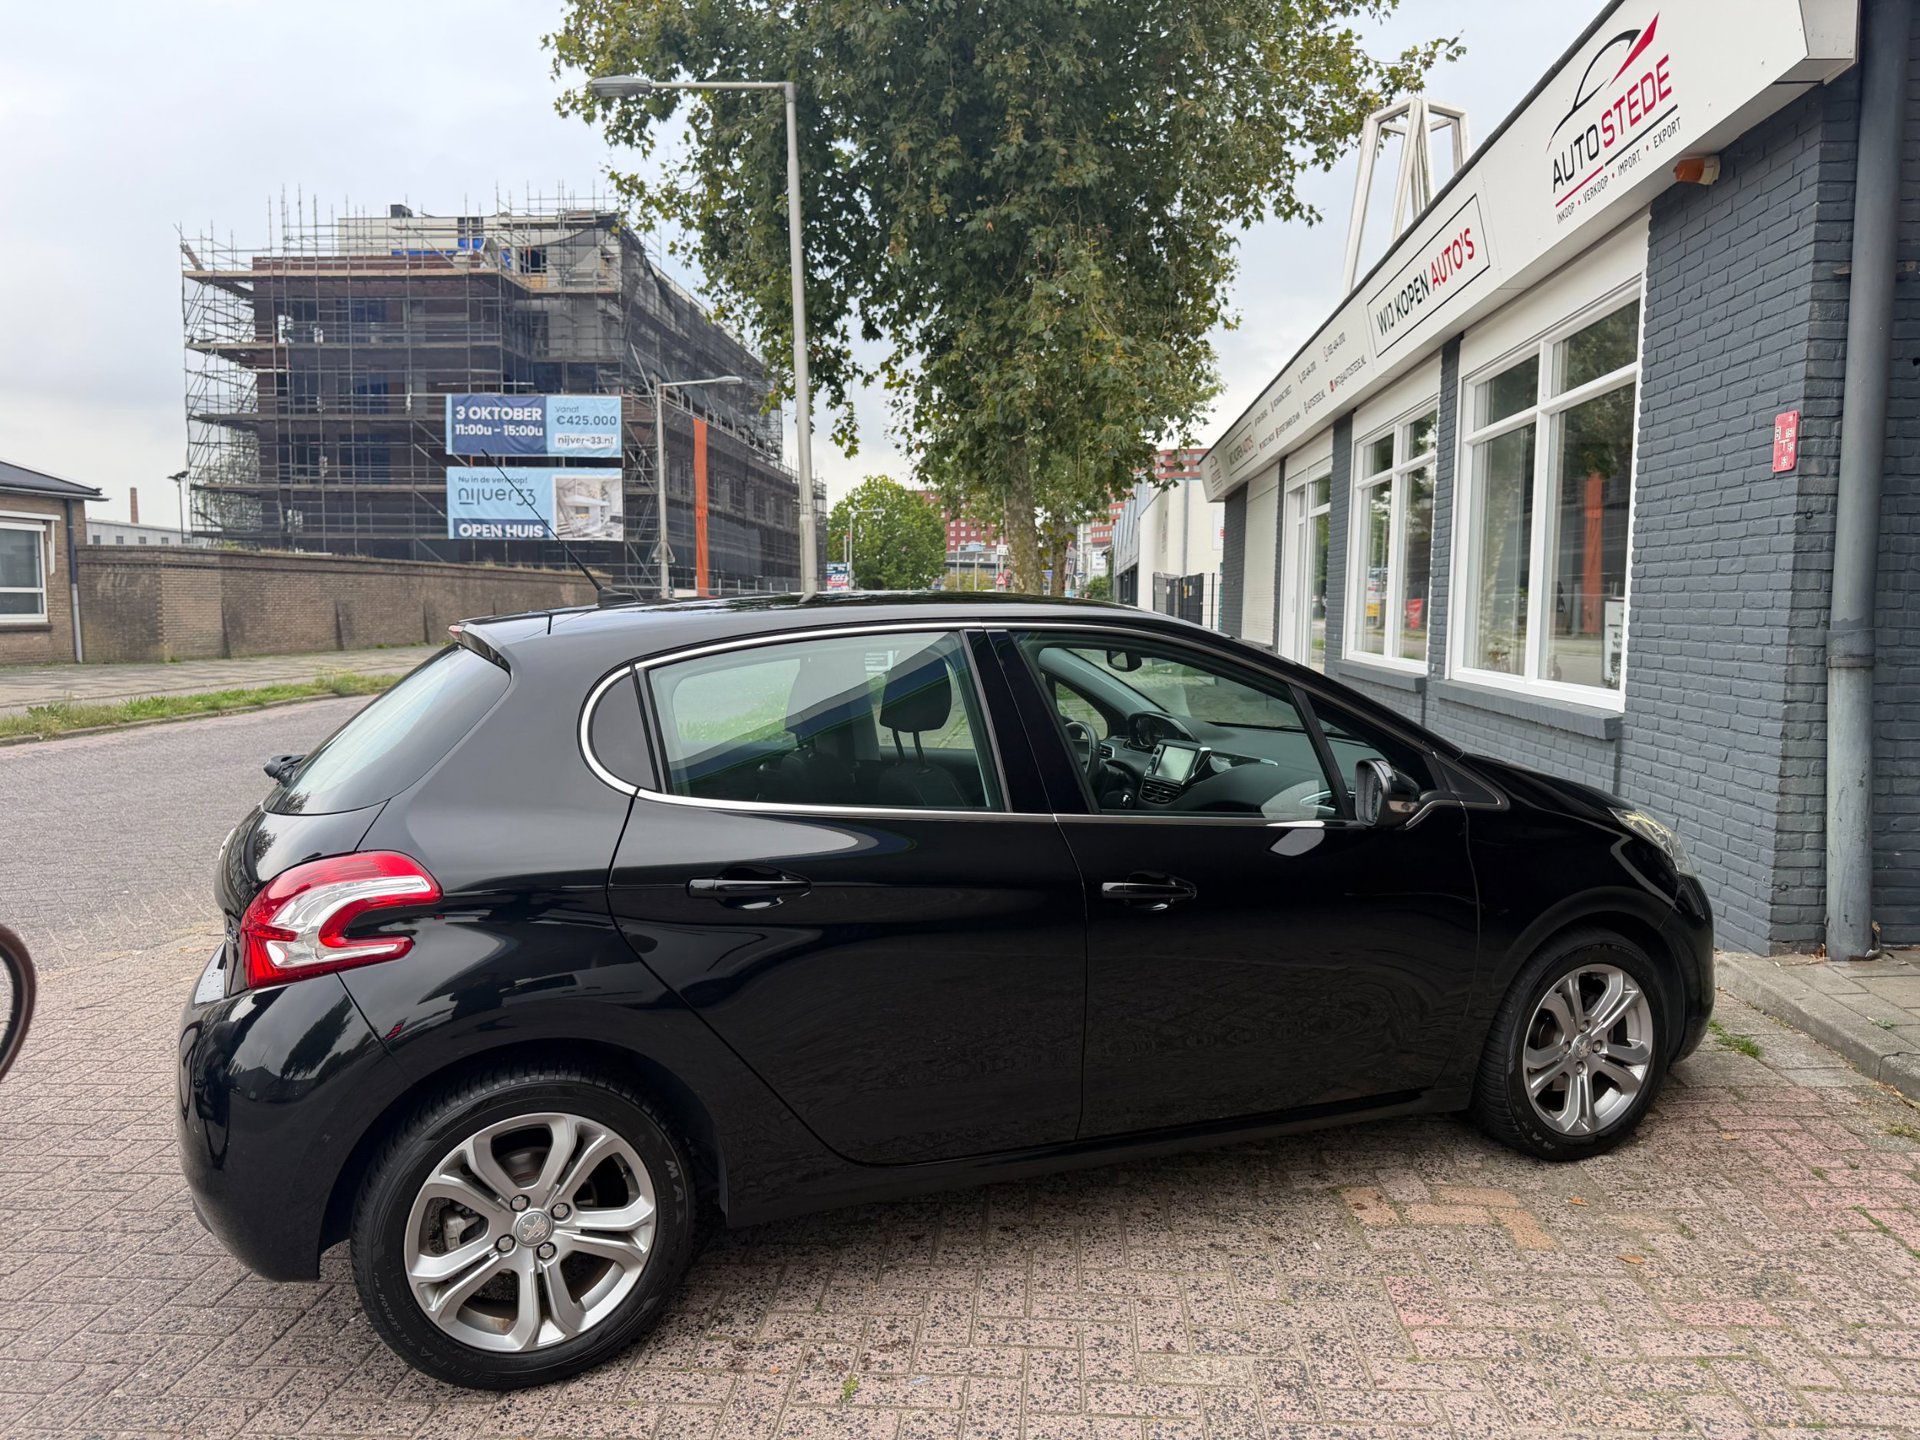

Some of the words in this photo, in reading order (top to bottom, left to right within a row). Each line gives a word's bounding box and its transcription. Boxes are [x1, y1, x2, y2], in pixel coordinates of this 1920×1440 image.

[1556, 202, 1575, 224] INKOOP
[1582, 175, 1609, 203] VERKOOP
[1617, 149, 1641, 176] IMPORT
[1653, 117, 1681, 149] EXPORT
[1376, 302, 1395, 336] WIJ
[1394, 269, 1430, 321] KOPEN
[1431, 227, 1475, 291] AUTO'S
[456, 405, 466, 420] 3
[468, 406, 542, 421] OKTOBER
[455, 424, 492, 435] 11:00u
[503, 425, 543, 436] 15:00u
[557, 435, 614, 447] nijver-33.nl
[458, 476, 470, 484] Nu
[471, 475, 479, 484] in
[480, 476, 490, 484] de
[458, 523, 502, 538] OPEN
[505, 524, 544, 538] HUIS
